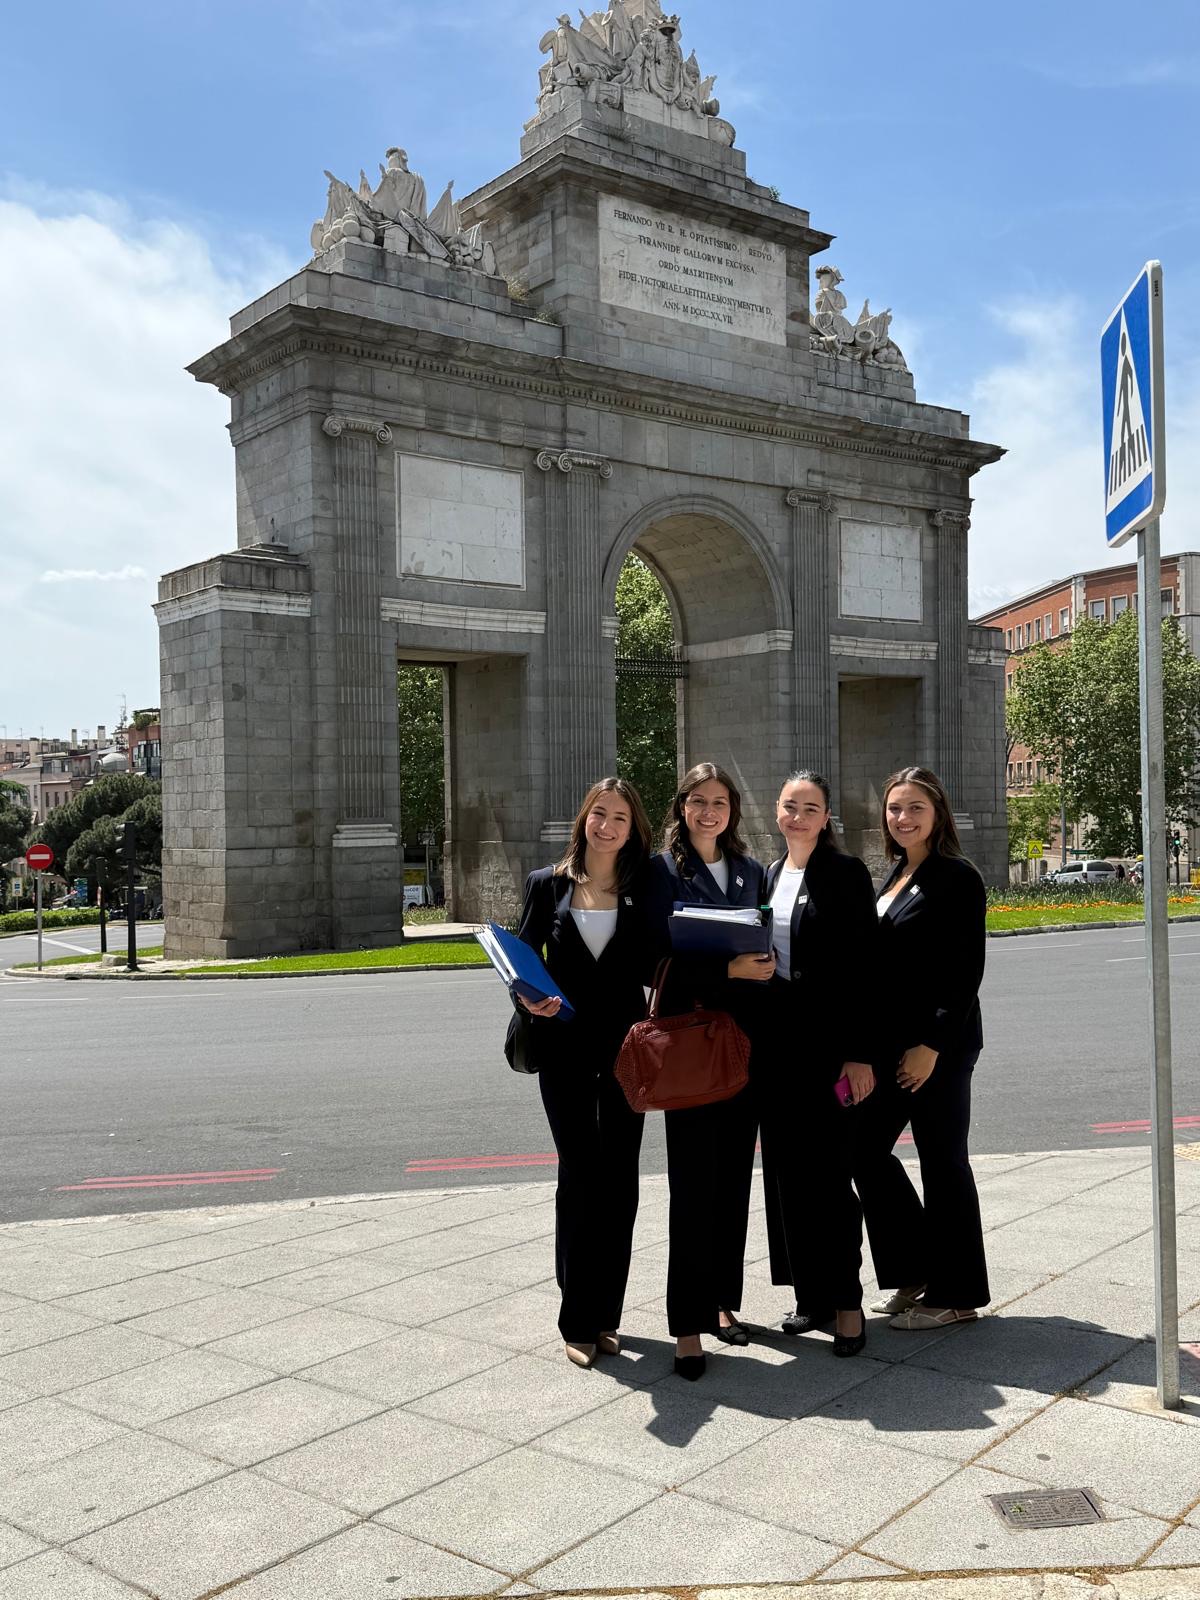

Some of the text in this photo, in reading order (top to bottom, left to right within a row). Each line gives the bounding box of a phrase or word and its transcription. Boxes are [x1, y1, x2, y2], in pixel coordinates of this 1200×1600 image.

[614, 209, 652, 226] FERNANDO
[638, 234, 681, 253] TYRANNIDE
[684, 248, 723, 265] GALLORVM
[658, 259, 734, 286] ORDO MATRITENSVM
